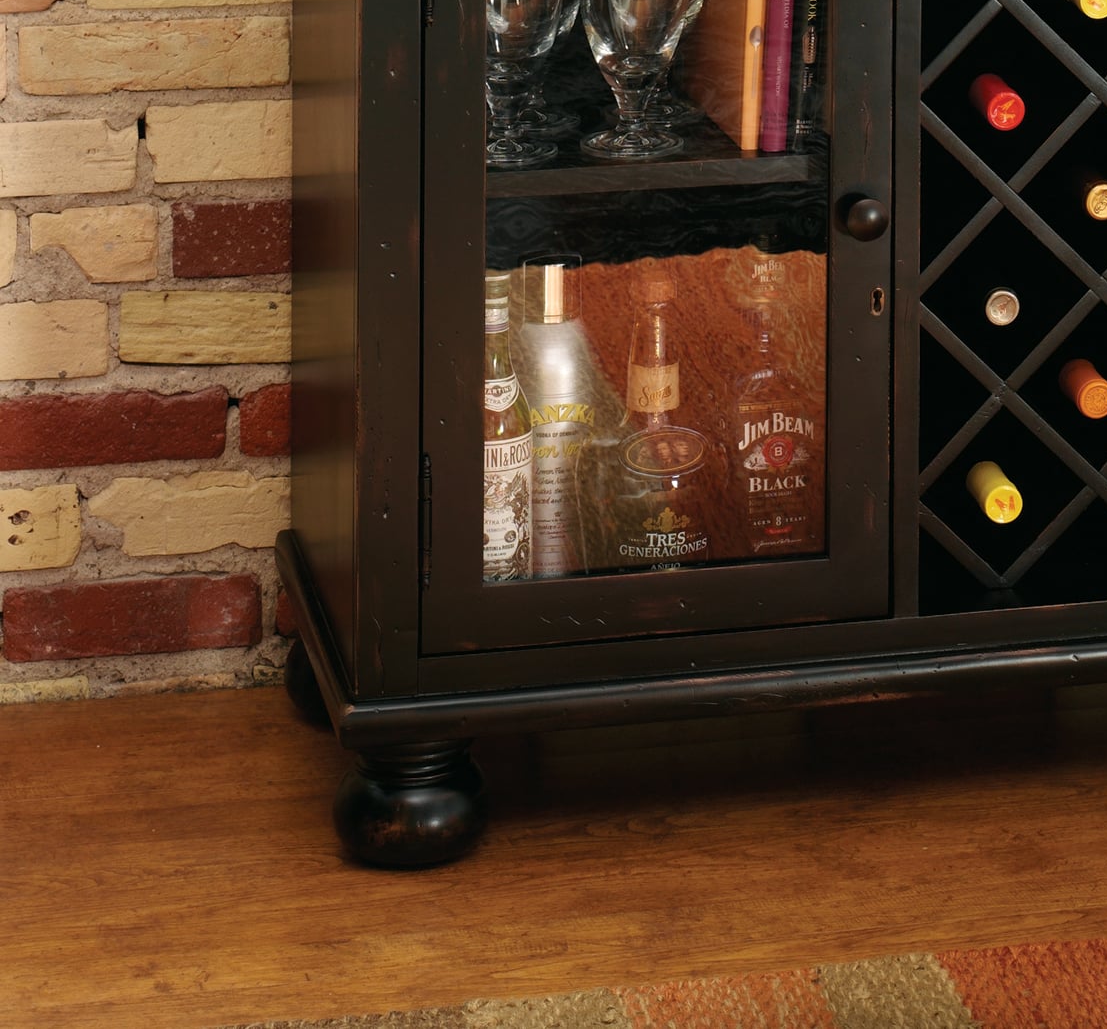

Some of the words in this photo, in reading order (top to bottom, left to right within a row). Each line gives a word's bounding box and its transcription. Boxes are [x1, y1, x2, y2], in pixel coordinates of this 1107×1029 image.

[530, 403, 595, 428] ANZKA
[738, 419, 770, 451] JIM
[772, 412, 814, 441] BEAM
[749, 474, 806, 493] BLACK
[775, 515, 782, 526] 8
[619, 538, 707, 558] GENERACIONES
[646, 531, 686, 547] TRES
